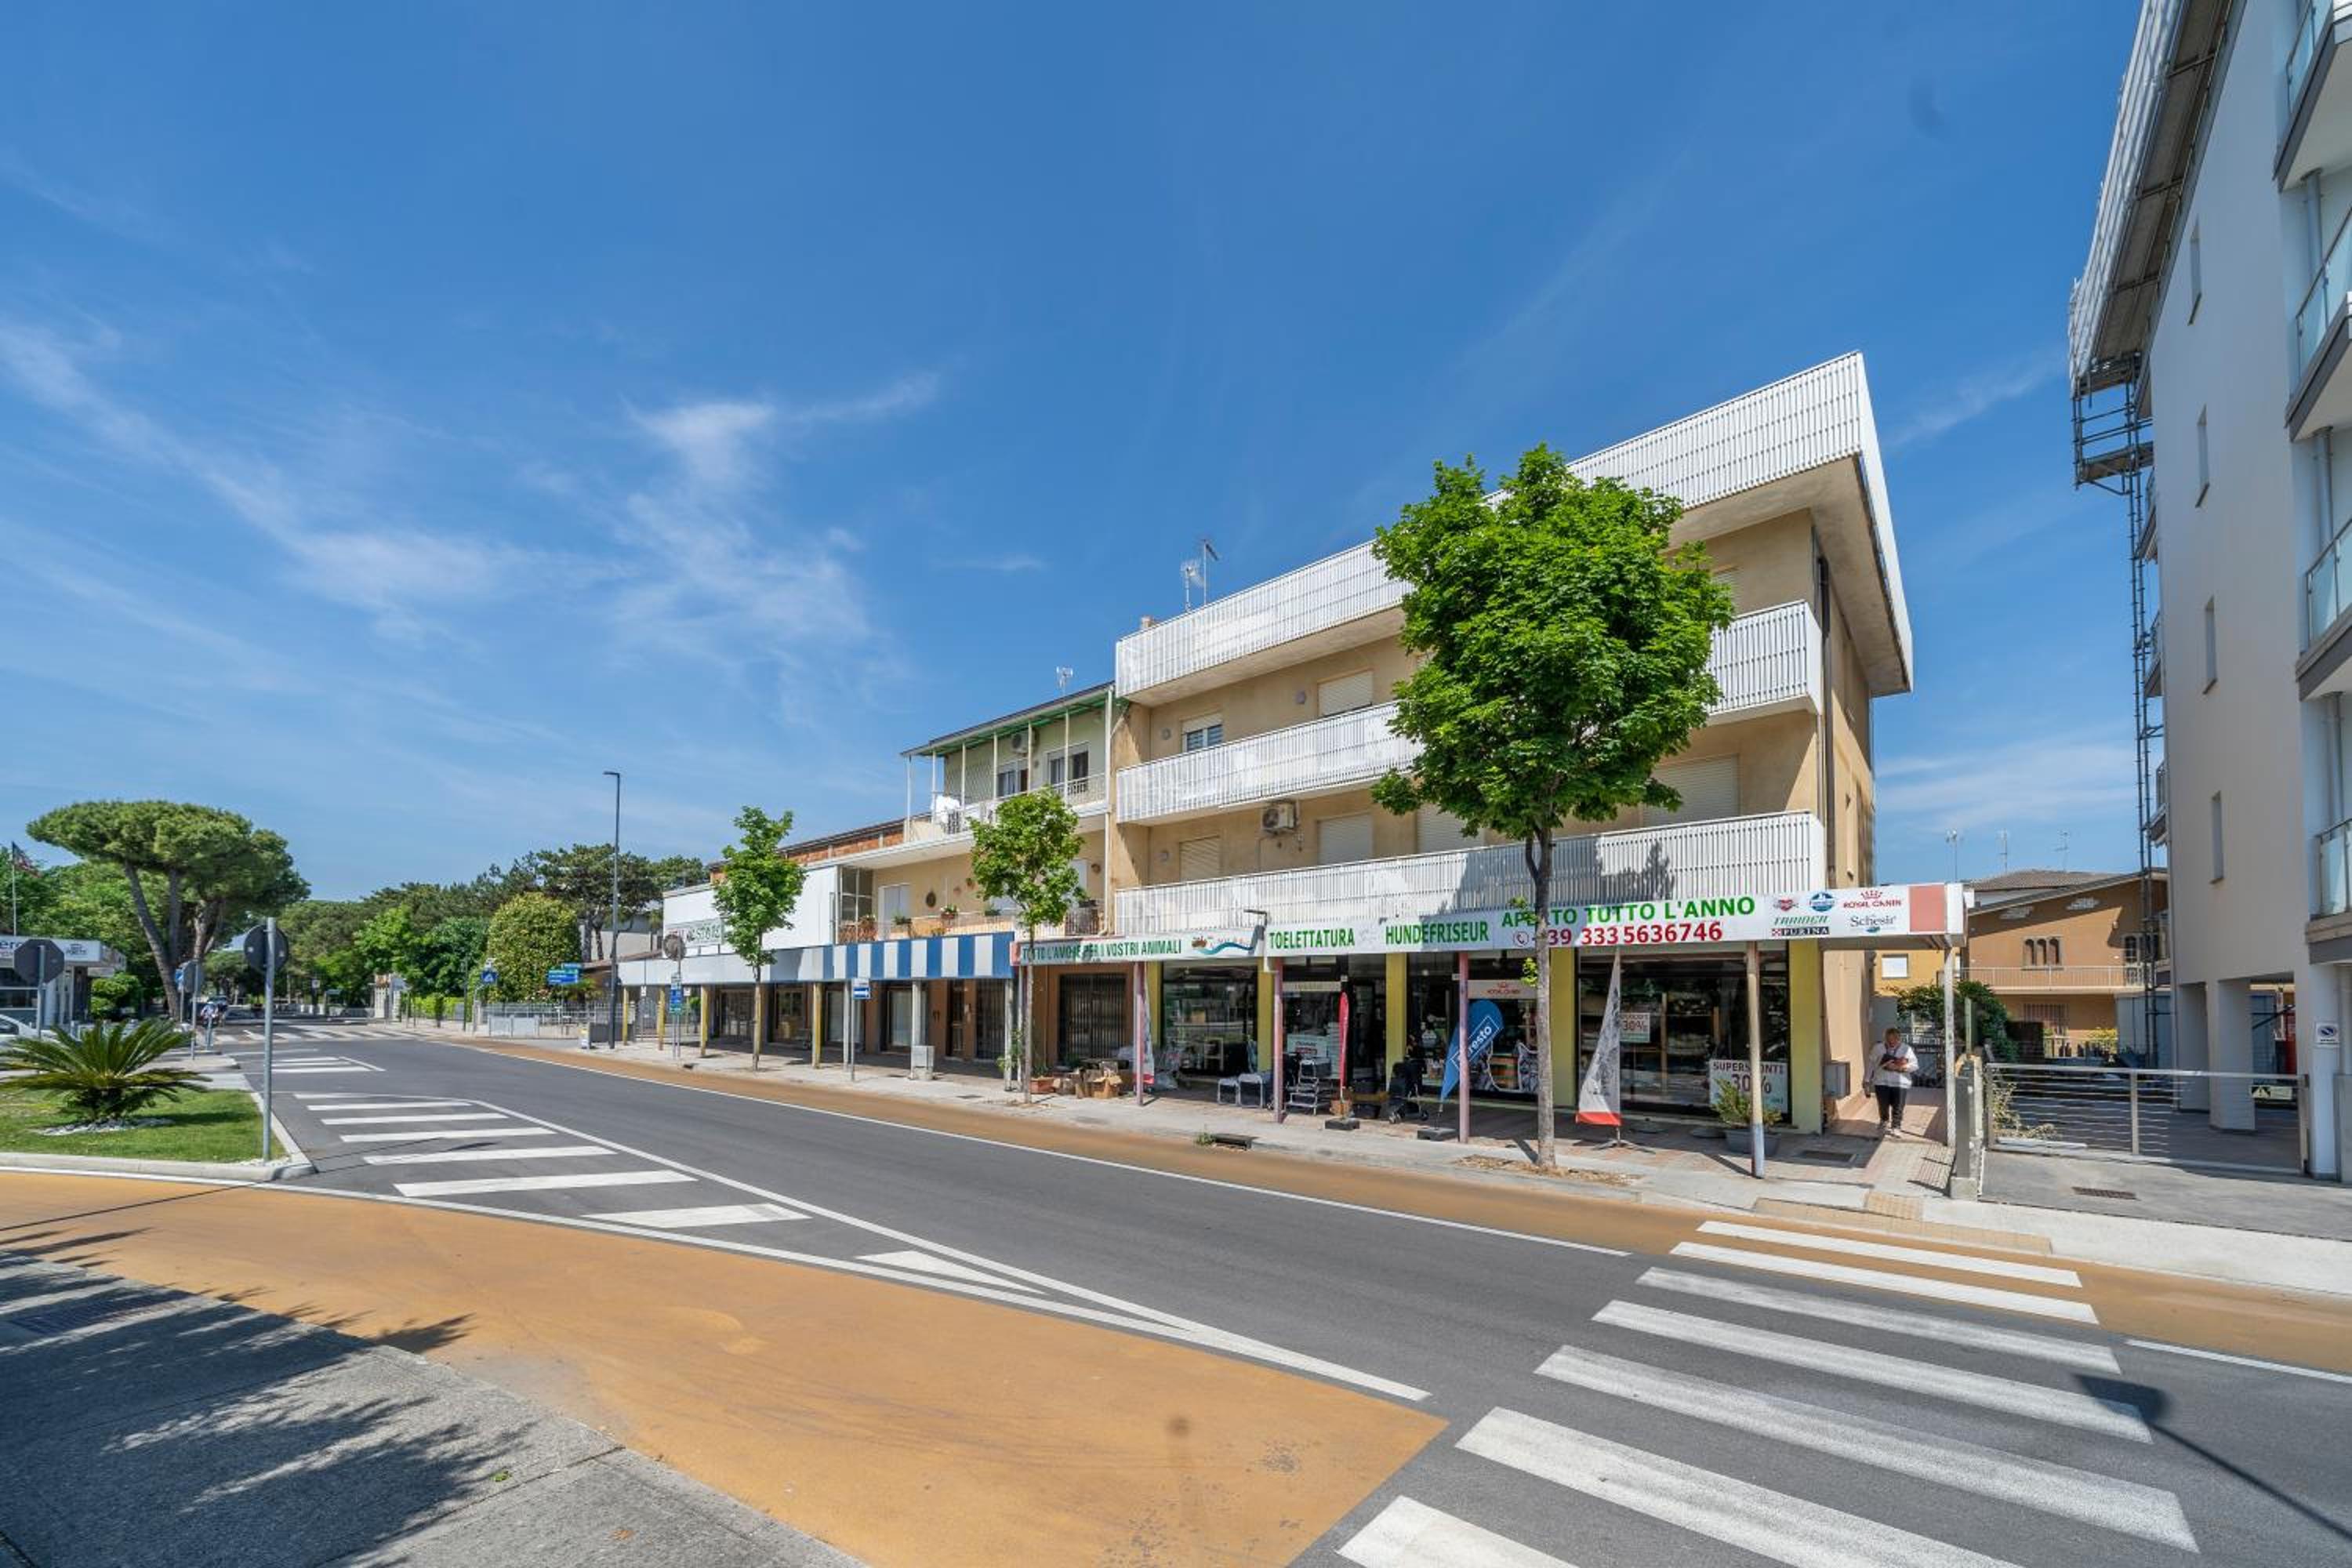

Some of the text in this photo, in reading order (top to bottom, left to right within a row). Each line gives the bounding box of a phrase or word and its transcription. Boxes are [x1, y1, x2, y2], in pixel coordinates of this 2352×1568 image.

[1584, 903, 1656, 924] TUTTO
[1664, 896, 1755, 920] L'ANNO
[1269, 927, 1356, 949] TOELETTATURA
[1385, 920, 1490, 945] HUNDEFRISEUR
[1106, 940, 1138, 956] VOSTRI
[1141, 938, 1182, 955] ANIMALI
